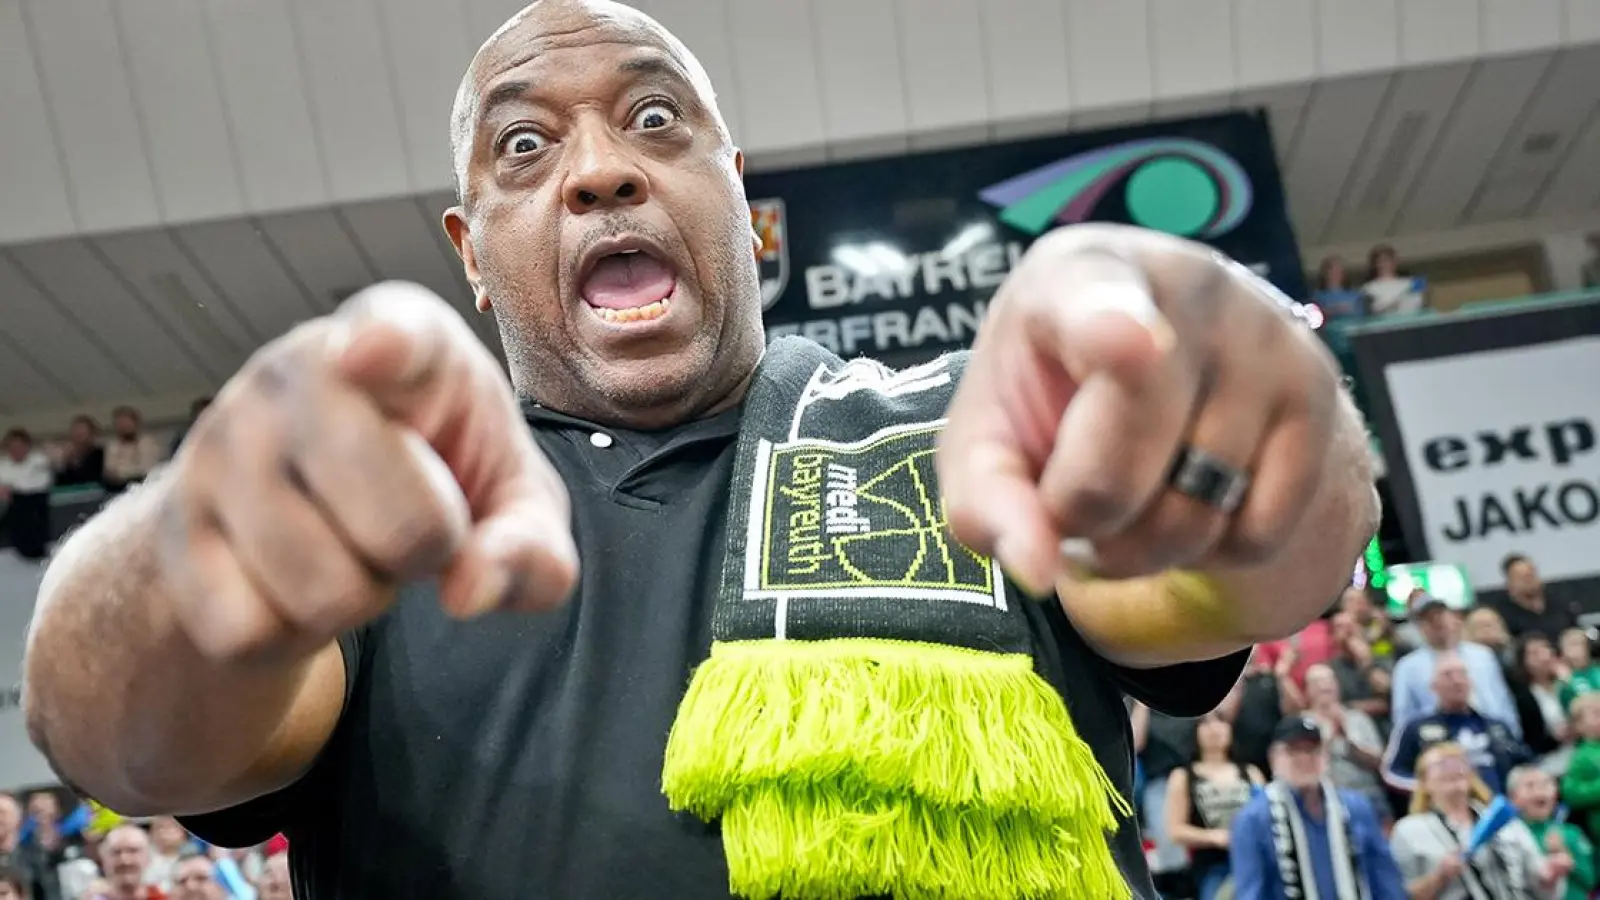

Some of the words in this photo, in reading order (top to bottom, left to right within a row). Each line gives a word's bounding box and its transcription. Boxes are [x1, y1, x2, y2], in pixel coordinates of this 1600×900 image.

[1423, 417, 1596, 472] exp
[780, 454, 834, 574] bayreuth
[826, 463, 870, 534] medi
[1443, 482, 1600, 542] JAKO
